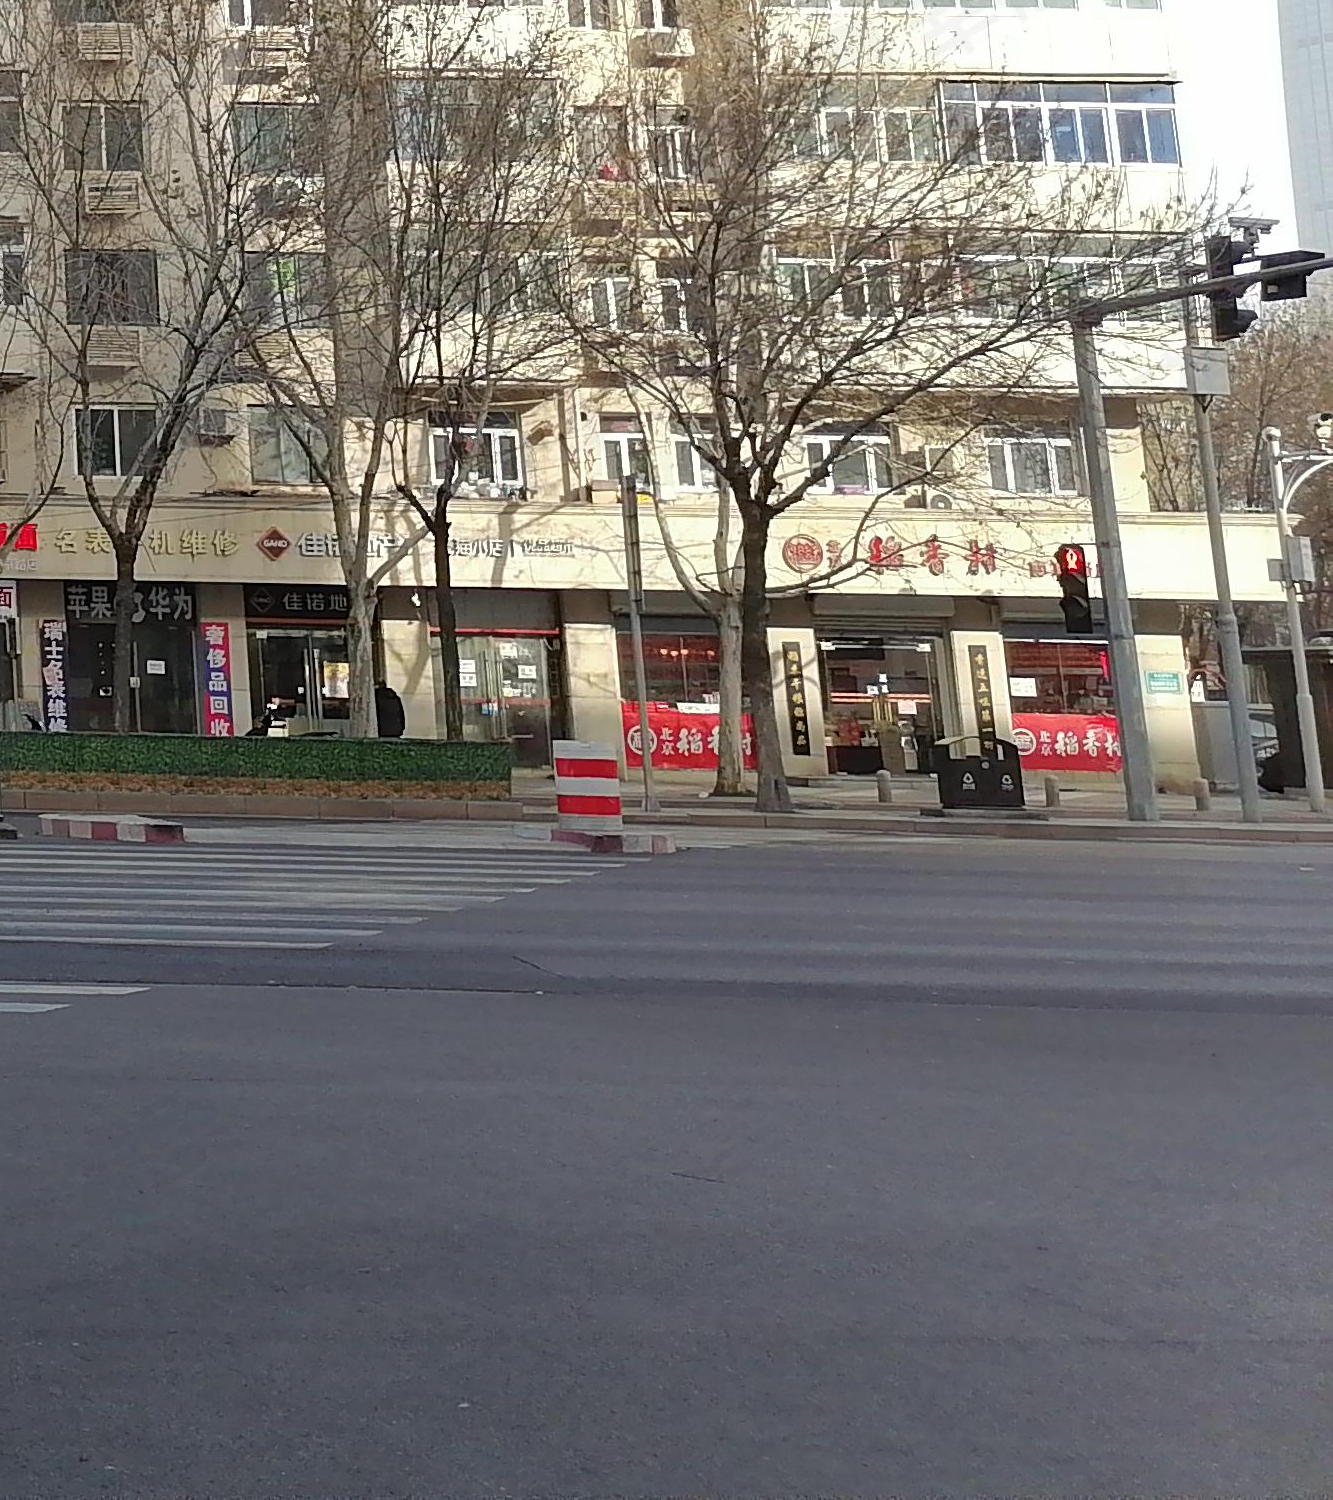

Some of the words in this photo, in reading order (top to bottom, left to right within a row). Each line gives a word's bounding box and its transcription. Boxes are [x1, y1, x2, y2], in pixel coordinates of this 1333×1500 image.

[55, 528, 239, 559] 名表机维修
[868, 534, 997, 576] 稻香村
[67, 585, 113, 619] 苹果
[148, 586, 193, 620] 华为
[283, 592, 347, 611] 佳诺地
[43, 621, 68, 733] 瑞士名表维修
[205, 625, 231, 736] 奢侈品回收
[660, 727, 674, 755] 北京
[1054, 730, 1121, 757] 稻香村
